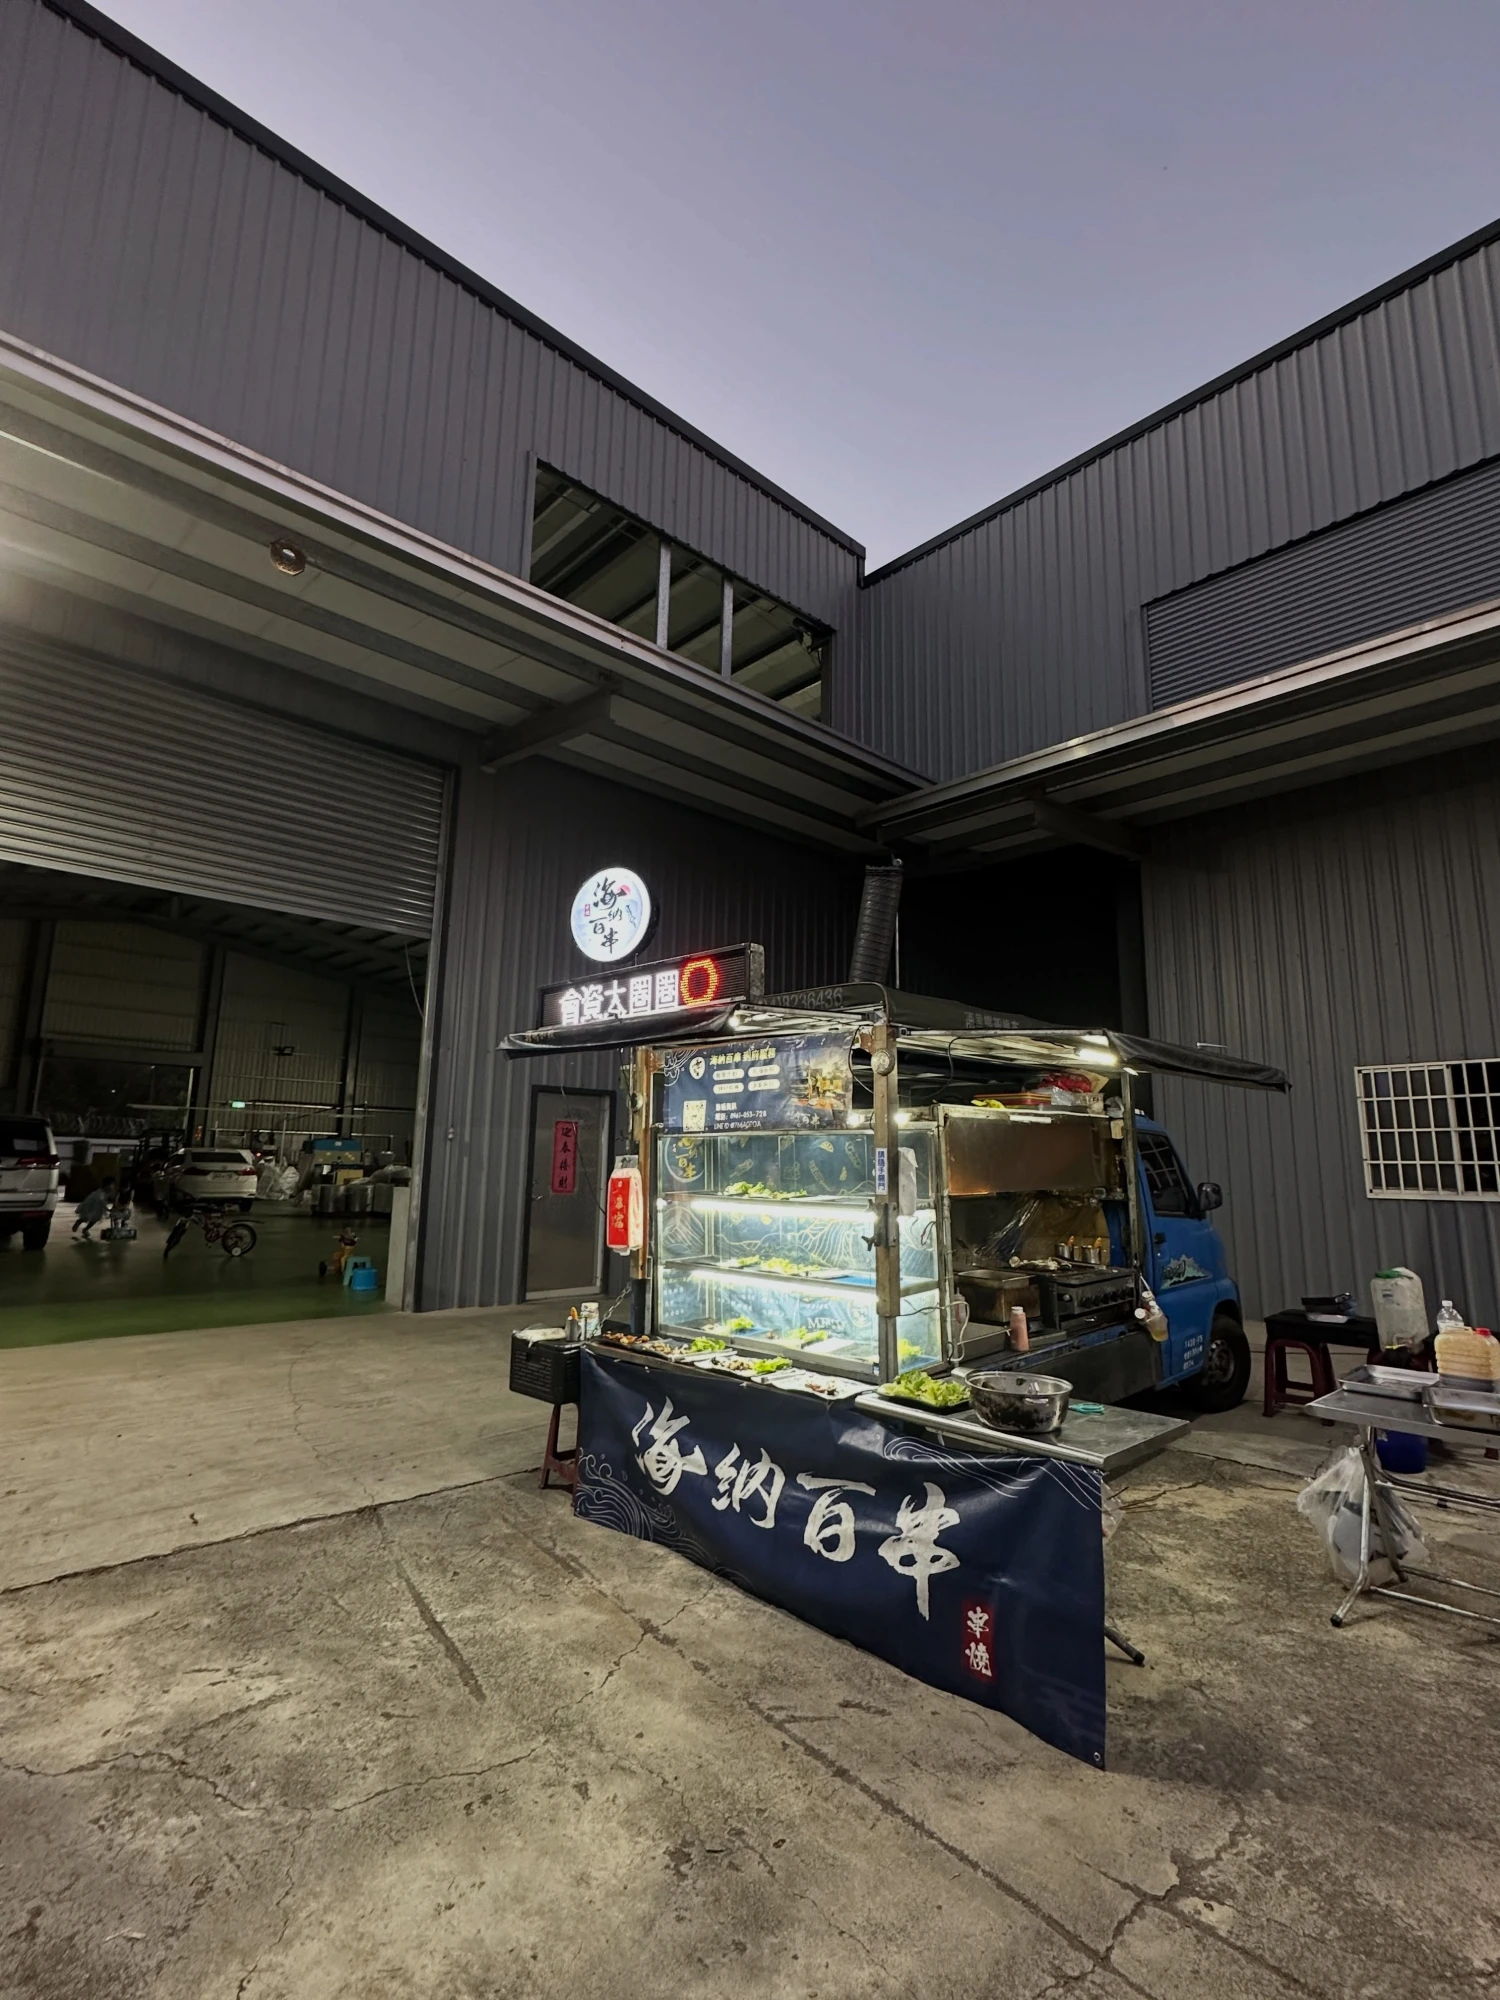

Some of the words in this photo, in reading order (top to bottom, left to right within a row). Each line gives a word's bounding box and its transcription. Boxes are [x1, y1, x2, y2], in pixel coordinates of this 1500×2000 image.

[631, 1396, 960, 1621] 海納百串
[965, 1606, 992, 1667] 串燒
